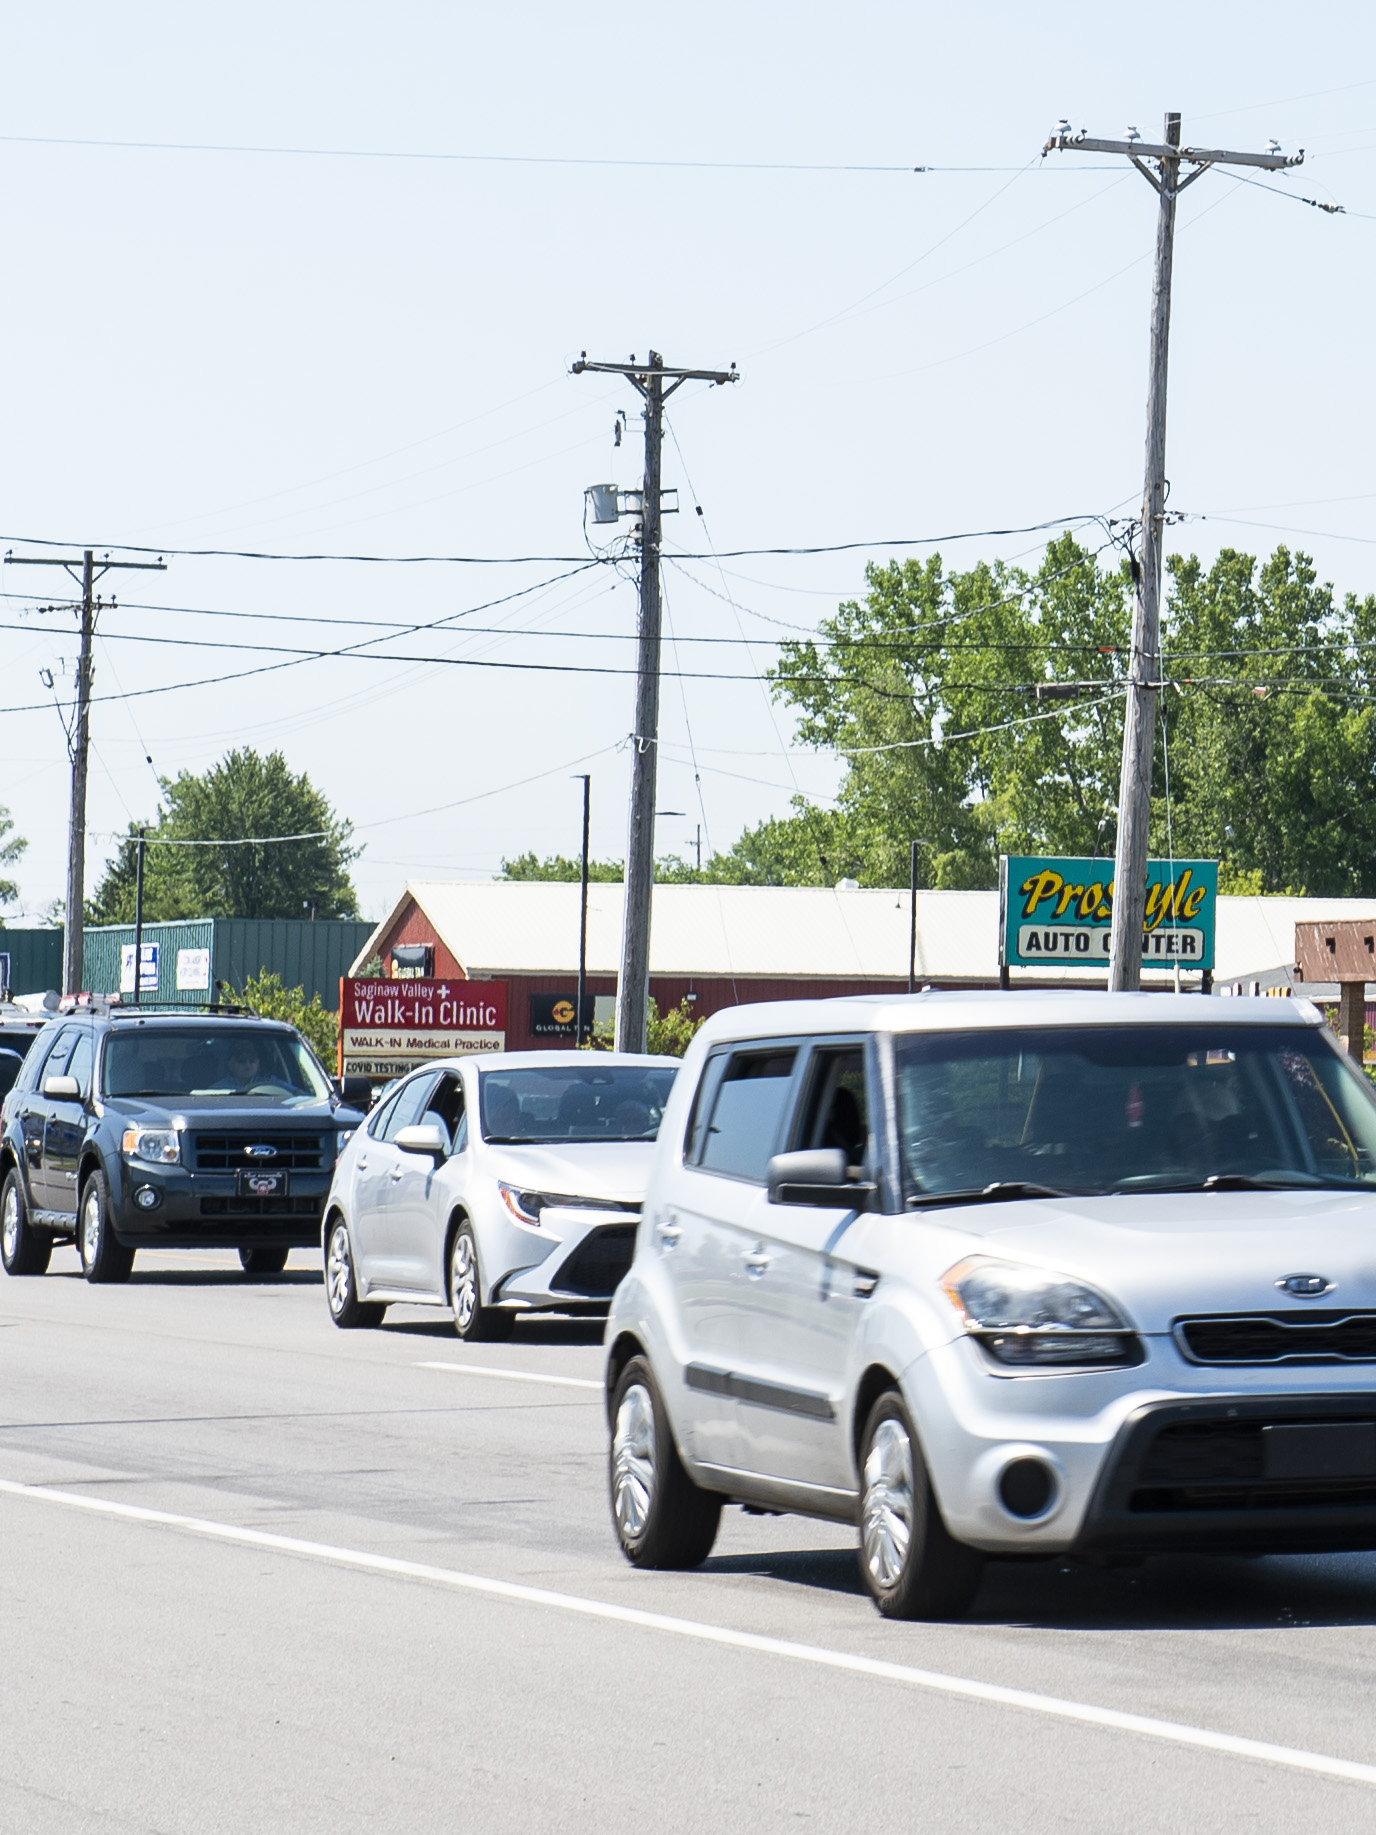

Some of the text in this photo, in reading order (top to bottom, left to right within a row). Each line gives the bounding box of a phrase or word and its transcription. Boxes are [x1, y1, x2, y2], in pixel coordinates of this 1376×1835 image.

[1019, 868, 1206, 932] ProSyle
[1026, 931, 1197, 954] AUTO CNTER
[354, 982, 434, 1001] Saginaw Valley
[354, 1000, 497, 1026] Walk-In Clinic
[535, 1024, 590, 1032] GLOBAL TN
[351, 1036, 500, 1050] WALK-IN Medical Practice
[345, 1062, 373, 1073] COVID
[373, 1063, 410, 1074] TESTING
